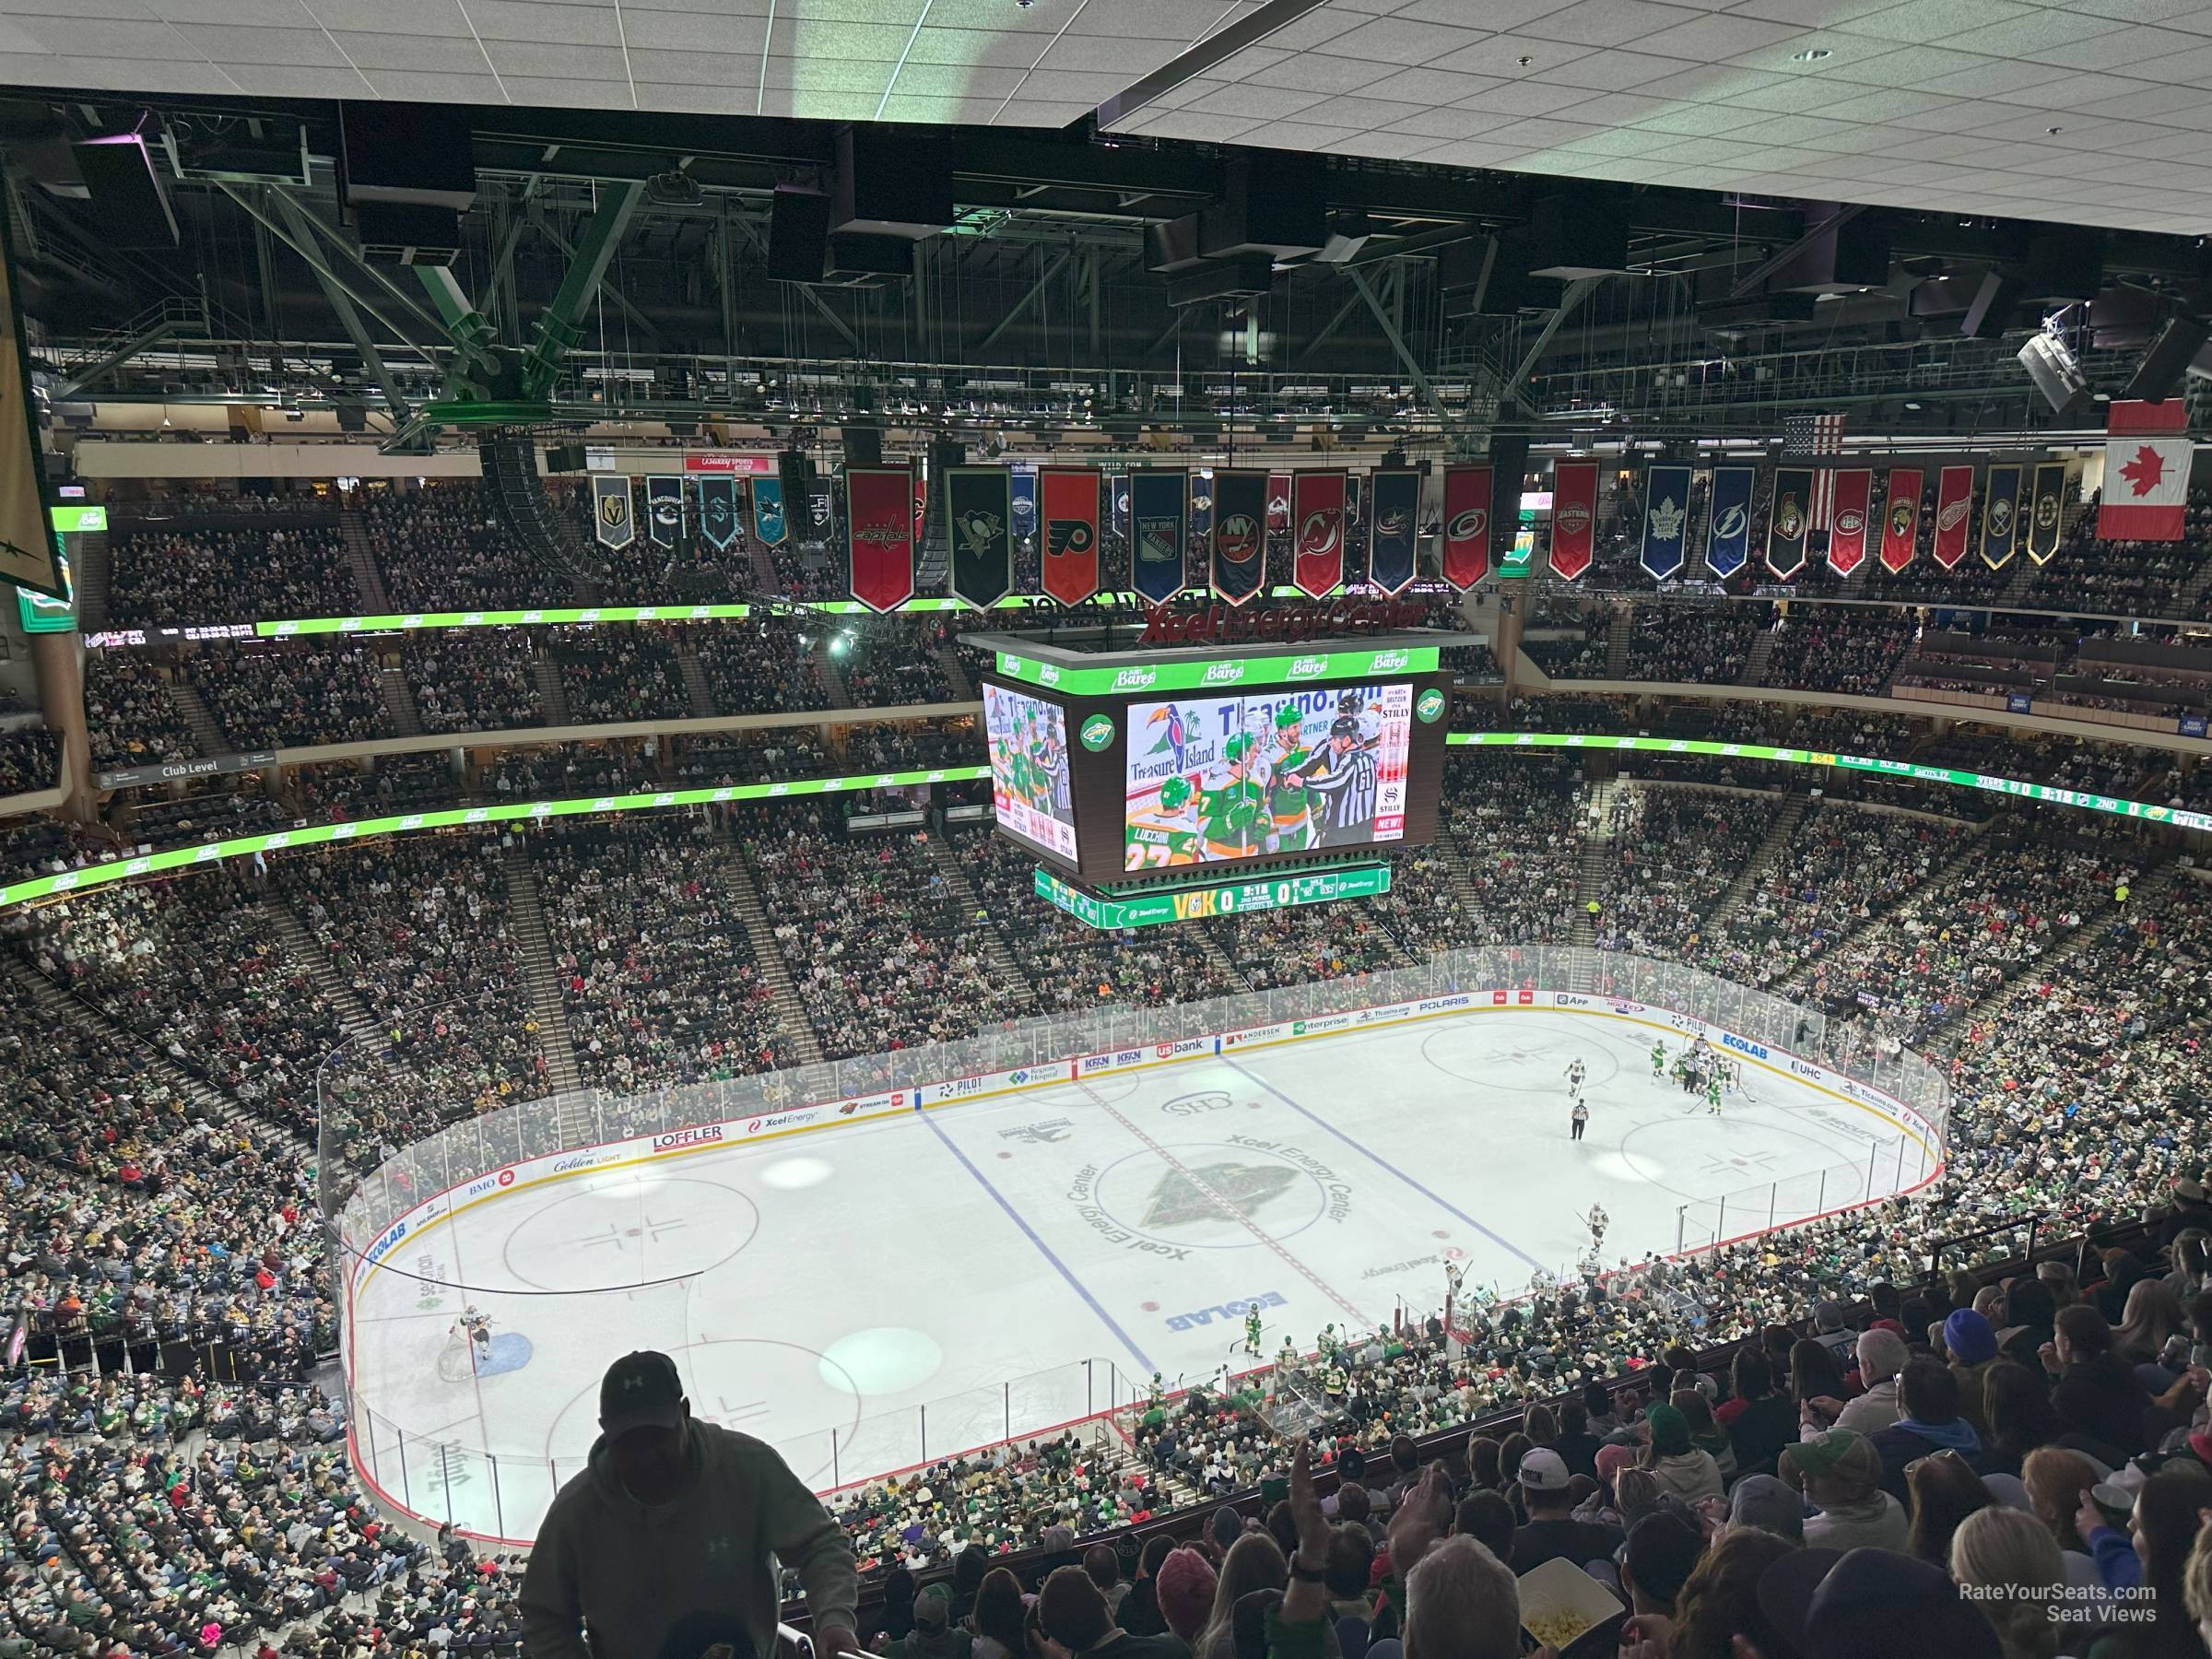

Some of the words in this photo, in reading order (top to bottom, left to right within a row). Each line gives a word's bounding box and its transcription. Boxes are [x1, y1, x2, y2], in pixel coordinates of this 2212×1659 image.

[1558, 510, 1590, 521] EASTERN
[1142, 521, 1157, 530] NEW
[1158, 521, 1175, 530] YORK
[1146, 532, 1173, 557] RANGERS
[1136, 606, 1218, 642] Xcel
[1222, 604, 1322, 643] Energy
[1328, 600, 1427, 633] Center
[1292, 661, 1324, 675] Bare
[1374, 654, 1404, 669] Bare
[1117, 671, 1153, 686] Bare
[1207, 665, 1239, 680] Bare
[1382, 709, 1410, 718] STILLY
[162, 765, 186, 777] Club
[189, 760, 218, 773] Level
[1131, 757, 1175, 781] Treasure
[1184, 740, 1214, 769] Island
[1360, 770, 1371, 788] 61
[1979, 775, 2005, 786] VEGAS
[2041, 786, 2074, 804] 9:18
[2095, 799, 2117, 810] 2ND
[2129, 802, 2139, 816] 0
[1377, 818, 1402, 830] NEW!
[1134, 828, 1169, 844] LUCCHINI
[1243, 884, 1268, 897] 9:18
[1277, 883, 1289, 904] 0
[1173, 889, 1217, 920] VGK
[1220, 890, 1233, 912] 0
[1419, 996, 1469, 1011] POLARIS
[1687, 1018, 1707, 1032] PILOT
[1243, 1028, 1280, 1040] ANDERSEN
[1174, 1040, 1203, 1053] bank
[1723, 1033, 1768, 1060] ECOLAB
[1030, 1065, 1056, 1075] Regions
[1030, 1071, 1059, 1082] Hospital
[1800, 1064, 1821, 1080] UHC
[958, 1077, 982, 1091] PILOT
[859, 1101, 880, 1110] STREAM
[765, 1117, 786, 1127] Xcel
[787, 1112, 818, 1124] Energy
[653, 1125, 723, 1148] LOFFLER
[554, 1158, 594, 1172] Golden
[597, 1154, 621, 1164] LIGHT
[469, 1179, 495, 1195] BMO
[1067, 1163, 1099, 1202] Center
[1227, 1134, 1283, 1150] Xcel
[1279, 1147, 1340, 1182] Energy
[1328, 1182, 1353, 1225] Center
[1077, 1205, 1132, 1243] Energy
[368, 1223, 406, 1267] ECOLAB
[1127, 1239, 1196, 1261] Xcel
[1360, 1261, 1401, 1280] Energy
[1401, 1254, 1442, 1271] Xcel
[1165, 1291, 1288, 1332] ECOLAB
